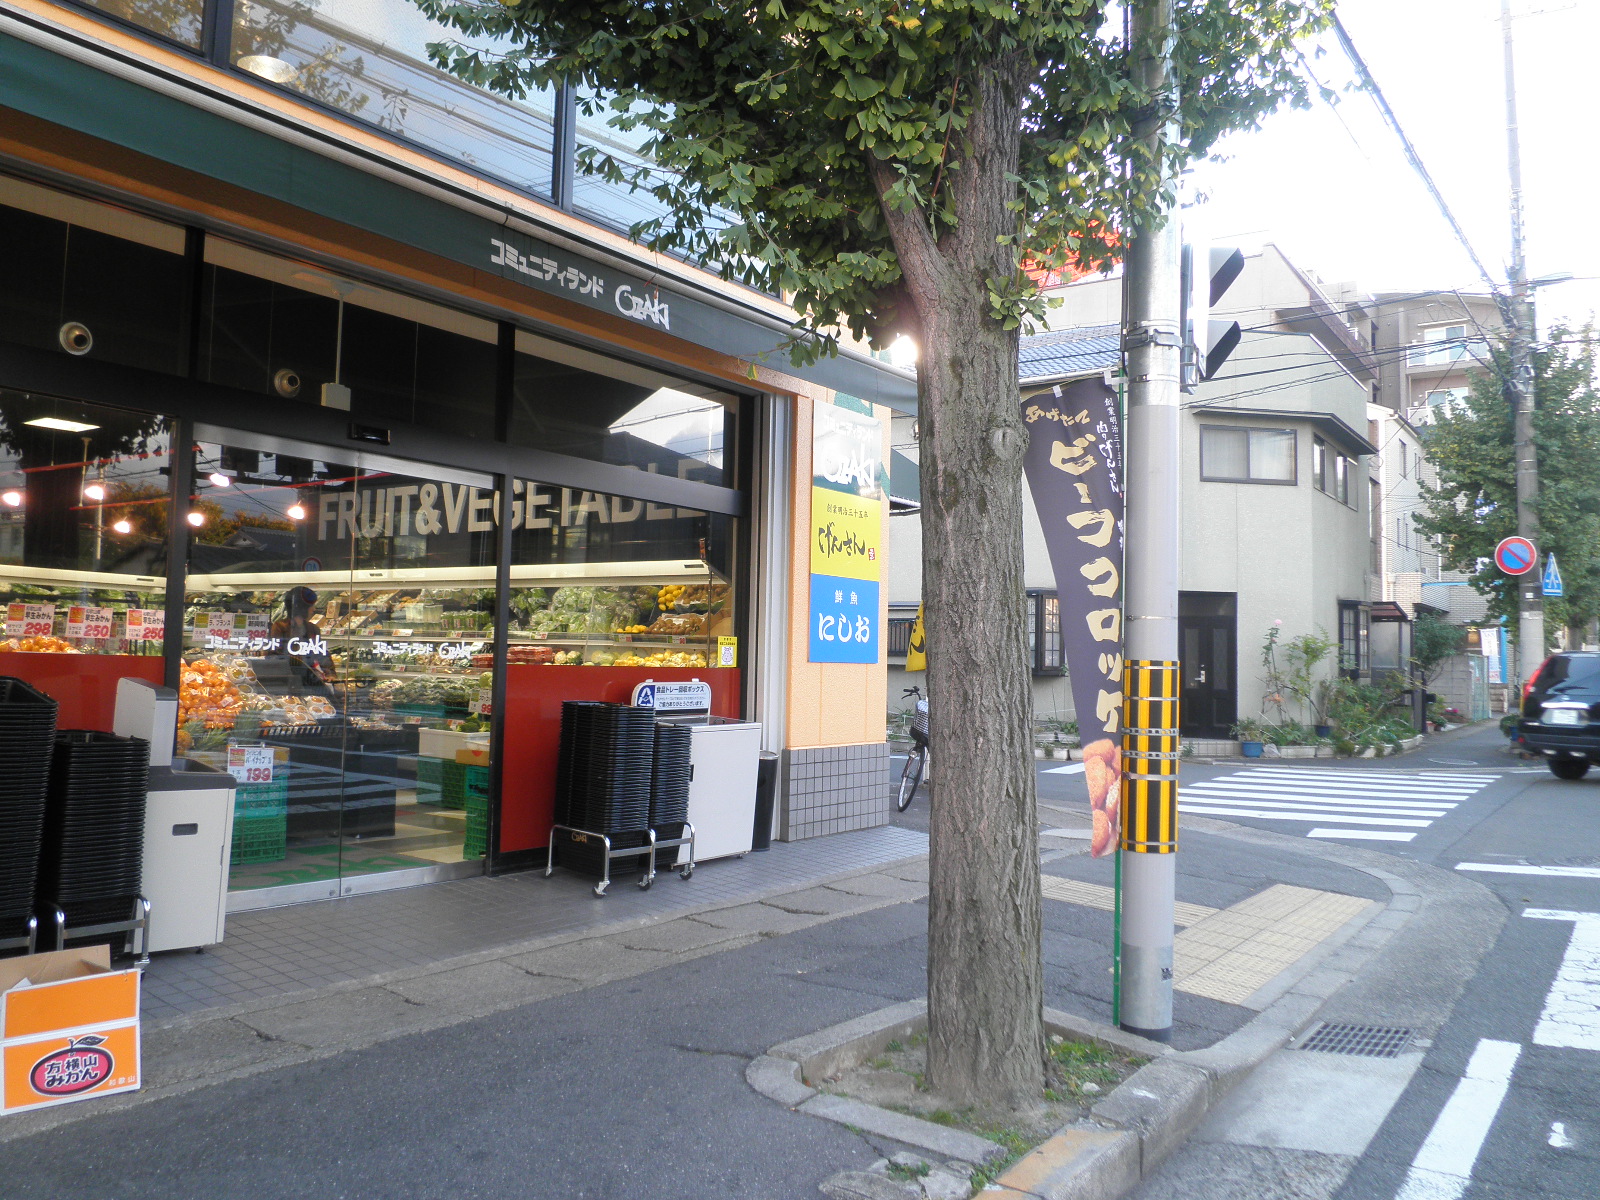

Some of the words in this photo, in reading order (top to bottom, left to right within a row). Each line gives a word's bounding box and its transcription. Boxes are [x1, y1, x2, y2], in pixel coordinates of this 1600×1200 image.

[490, 238, 604, 298] コミュニティランド
[818, 521, 866, 558] げんさん
[834, 589, 858, 606] 鮮魚
[23, 622, 52, 636] 298
[83, 624, 110, 638] 250
[818, 612, 871, 643] にしお
[204, 635, 280, 651] コミュニティランド
[247, 768, 271, 781] 199
[45, 1067, 100, 1088] みかん
